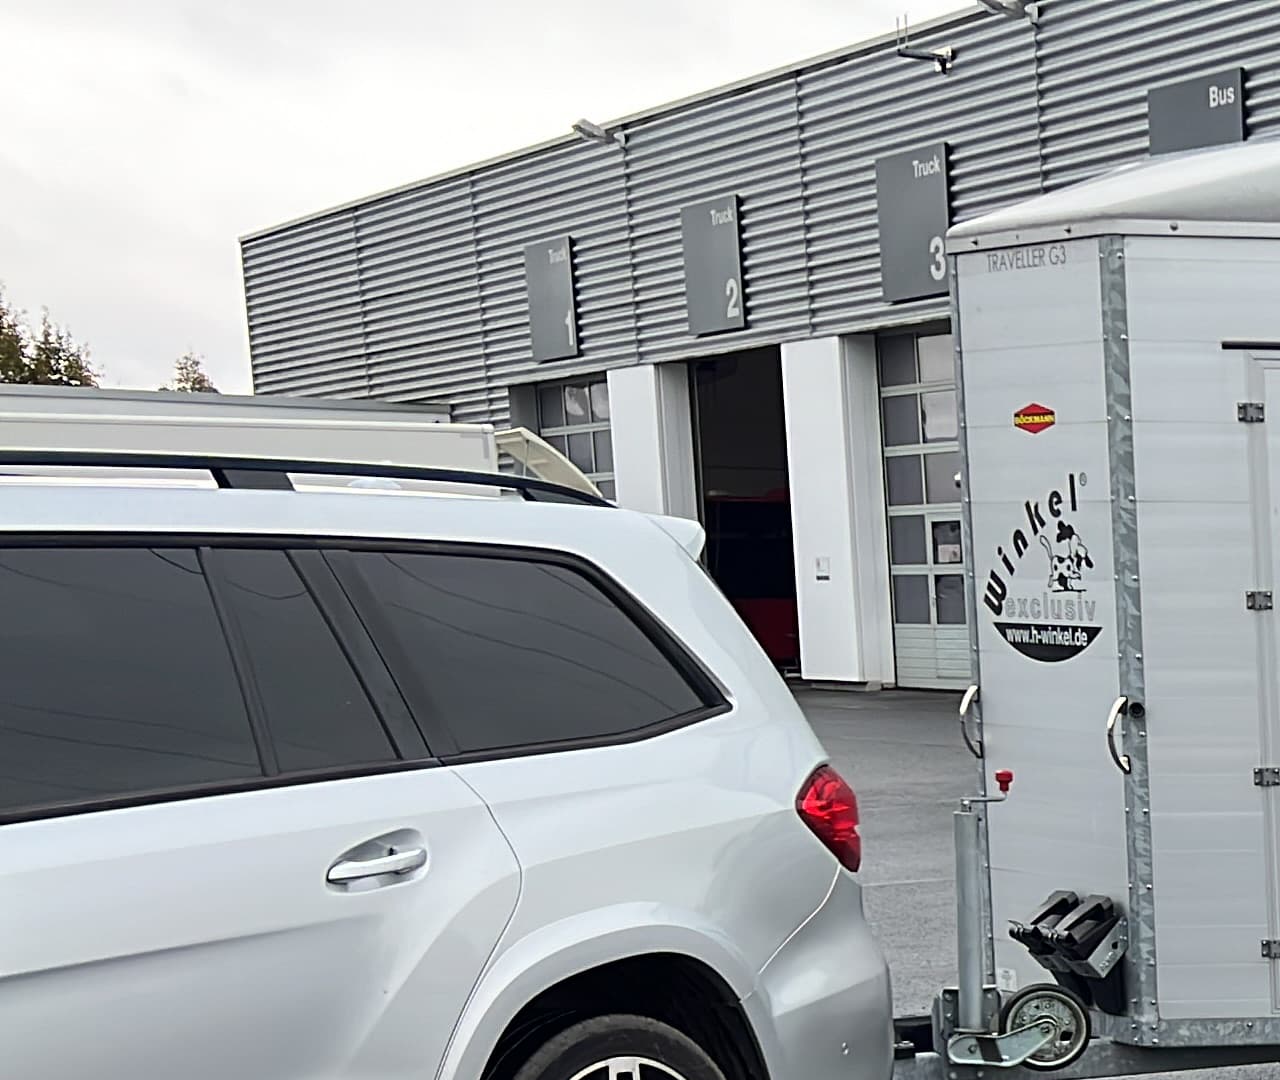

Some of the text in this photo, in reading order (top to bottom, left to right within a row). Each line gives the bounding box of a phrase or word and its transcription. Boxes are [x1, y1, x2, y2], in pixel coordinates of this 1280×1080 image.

[1209, 86, 1235, 108] Bus
[912, 155, 940, 178] Truck
[710, 206, 734, 226] Truck
[929, 236, 946, 280] 3
[986, 245, 1067, 273] TRAVELLER G3
[725, 278, 740, 318] 2
[565, 309, 574, 347] 1
[984, 473, 1077, 617] winkel
[1005, 592, 1096, 622] exclusiv
[1005, 625, 1088, 647] www.h-winkel.de
